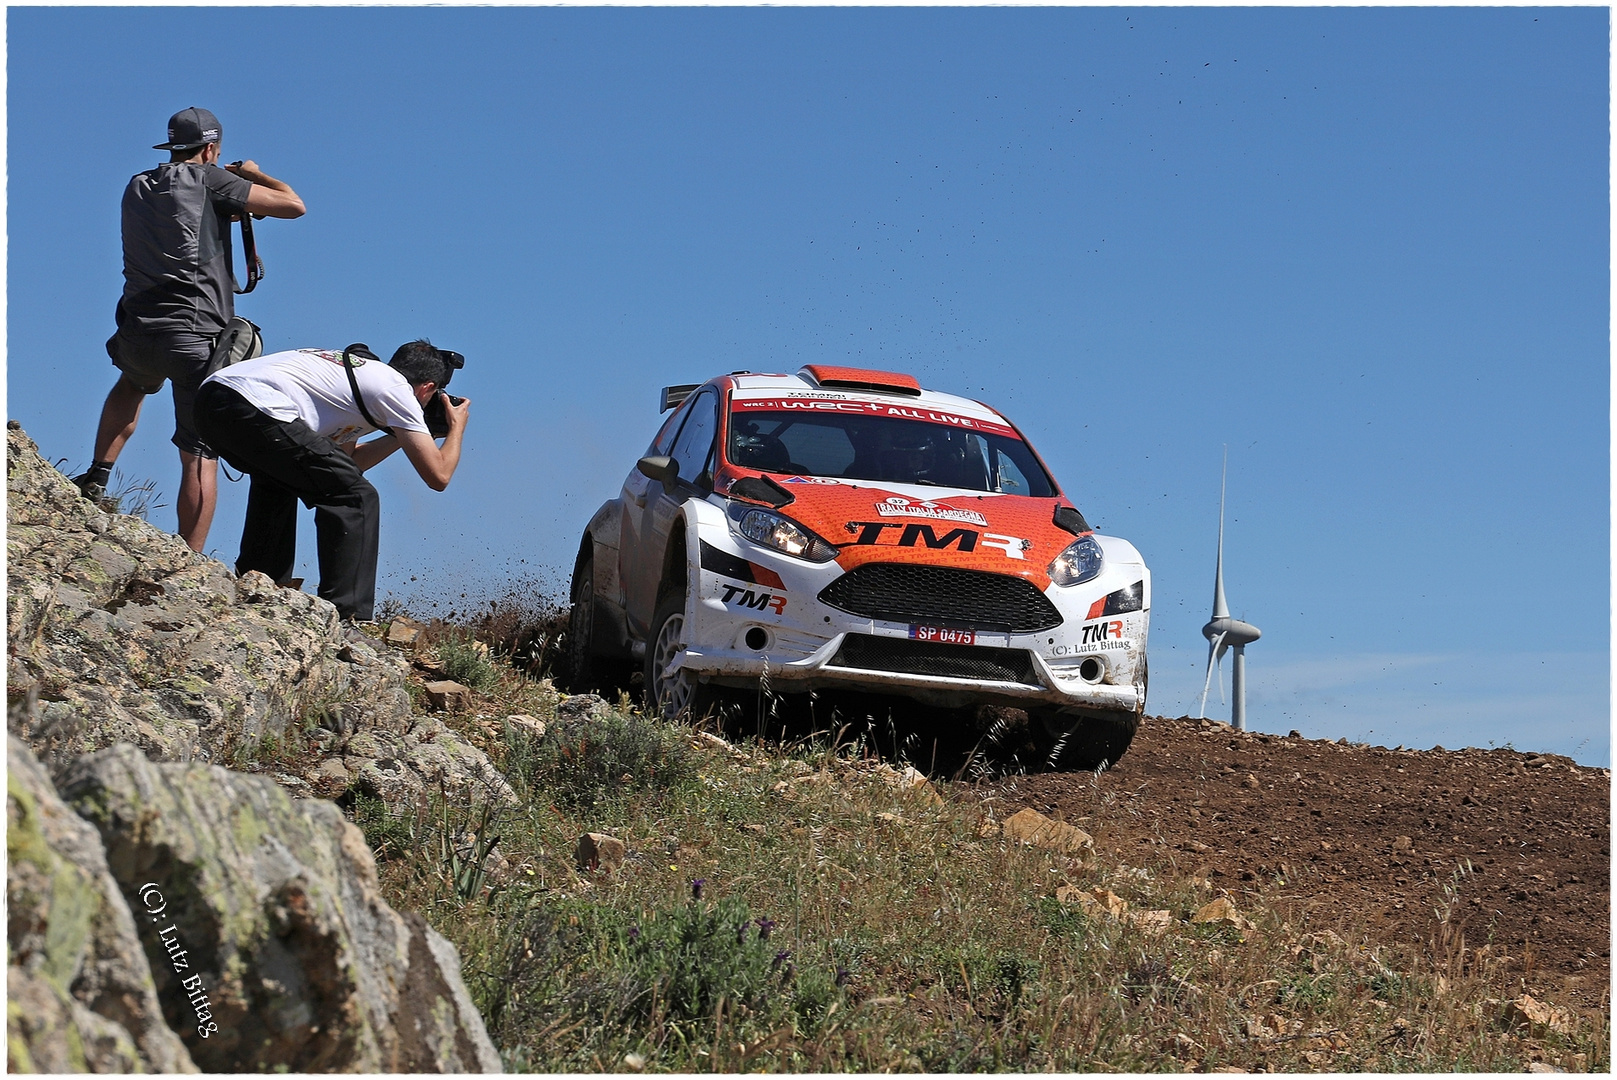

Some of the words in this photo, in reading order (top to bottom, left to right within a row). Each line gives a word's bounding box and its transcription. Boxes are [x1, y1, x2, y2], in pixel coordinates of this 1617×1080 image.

[888, 407, 926, 419] ALL
[929, 413, 974, 427] LIVE
[880, 503, 907, 513] RALLY
[907, 506, 936, 516] ITALIA
[936, 508, 985, 522] SARDEGNA
[849, 521, 1026, 560] TMR
[721, 583, 788, 616] TMR
[918, 626, 937, 640] SP
[940, 628, 971, 644] 0475
[1081, 620, 1123, 644] TMR
